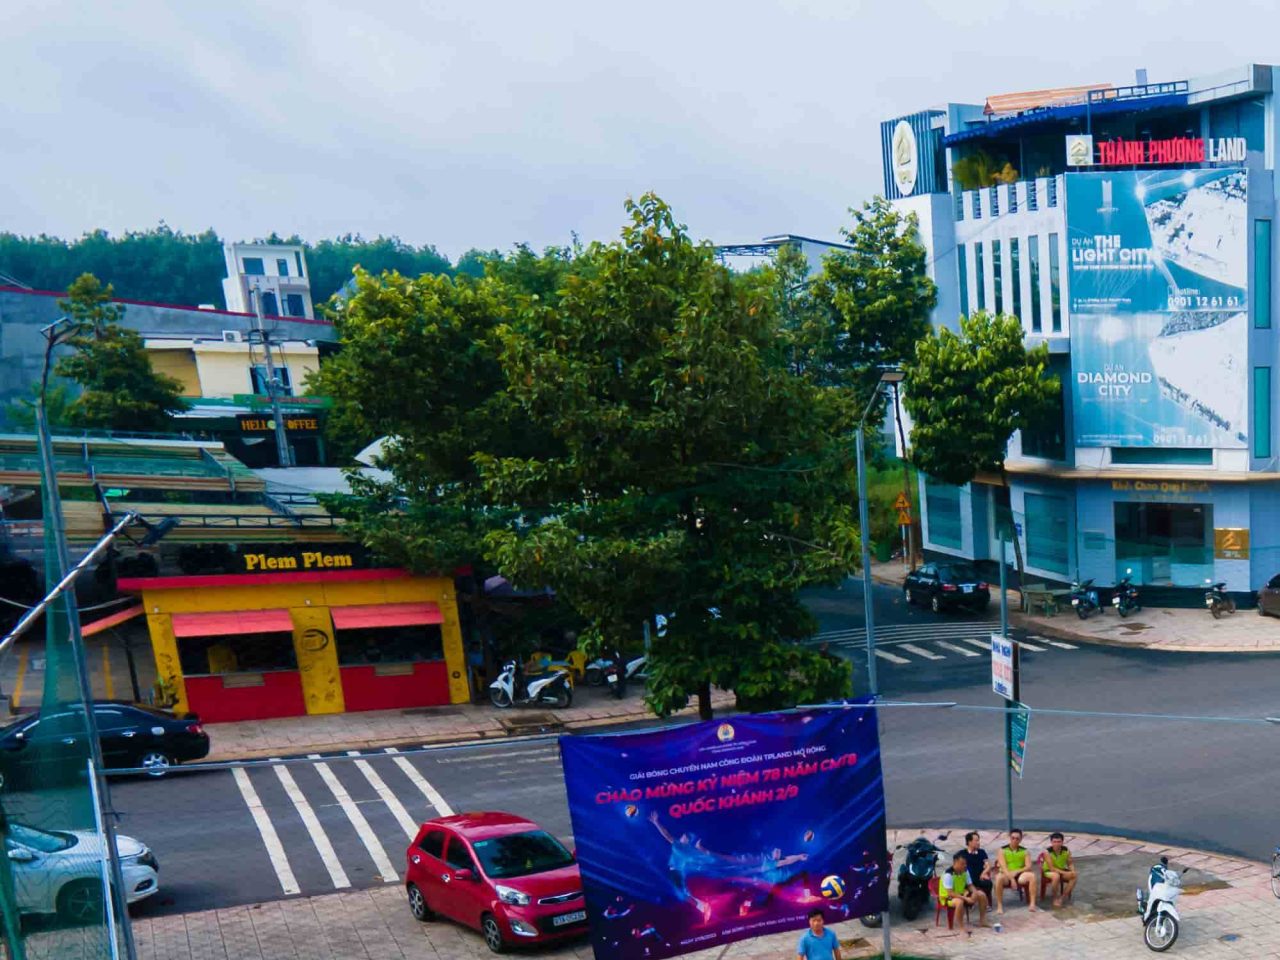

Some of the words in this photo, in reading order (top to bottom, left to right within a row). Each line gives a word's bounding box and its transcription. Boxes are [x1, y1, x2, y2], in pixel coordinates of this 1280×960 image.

[1097, 136, 1145, 165] THÀNH
[1149, 135, 1205, 163] PHƯƠNG
[1208, 137, 1247, 162] LAND
[1094, 235, 1120, 248] THE
[1072, 248, 1115, 262] LIGHT
[1120, 248, 1152, 262] CITY
[1167, 296, 1192, 306] 0901
[1196, 296, 1208, 306] 12
[1211, 296, 1222, 306] 61
[1227, 296, 1239, 306] 61
[1077, 372, 1152, 384] DIAMOND
[1098, 385, 1132, 396] CITY
[244, 553, 297, 570] Plem
[302, 551, 352, 568] Plem
[700, 761, 718, 770] NAM
[764, 751, 792, 760] TPLAND
[595, 787, 642, 804] CHÀO
[645, 781, 695, 799] MỪNG
[762, 767, 780, 783] 78
[783, 762, 818, 778] NĂM
[820, 753, 858, 772] CMT8
[669, 796, 716, 818] QUỐC
[719, 787, 774, 809] KHÁNH
[776, 784, 799, 801] 2/9
